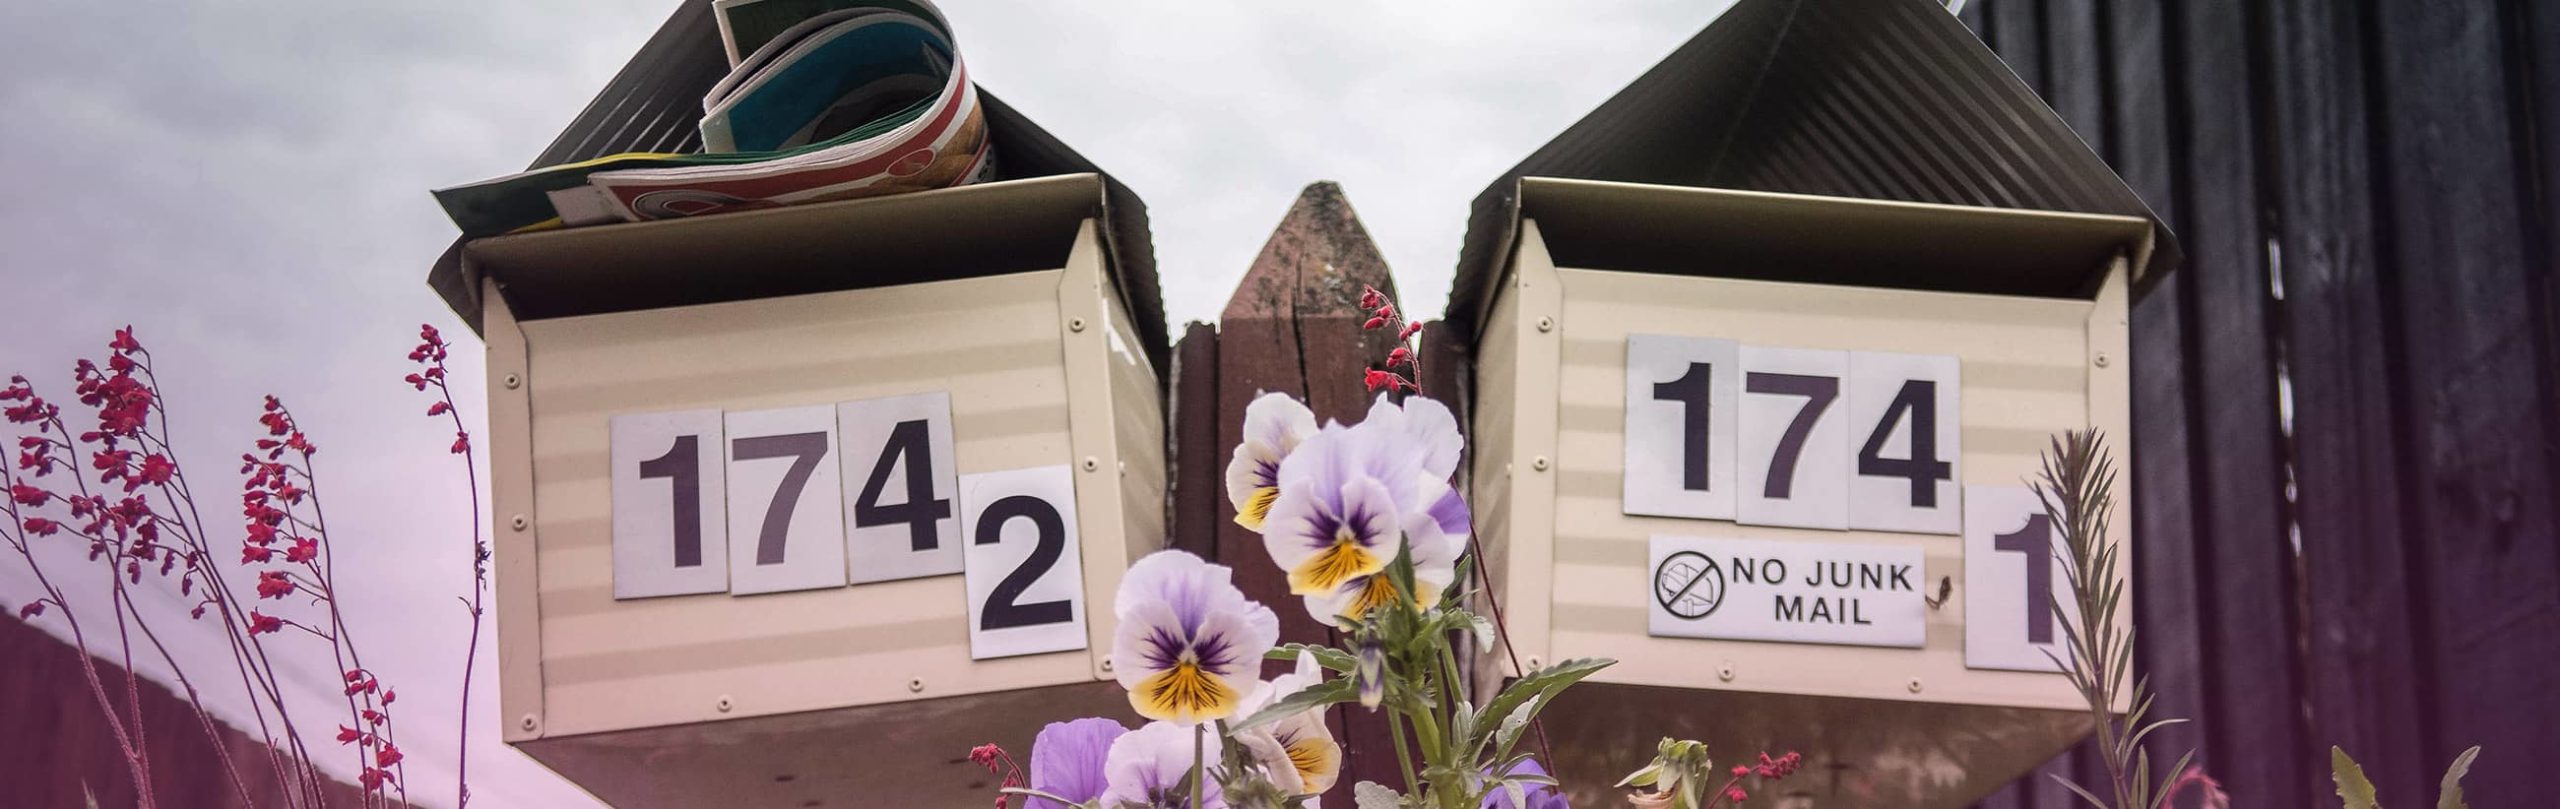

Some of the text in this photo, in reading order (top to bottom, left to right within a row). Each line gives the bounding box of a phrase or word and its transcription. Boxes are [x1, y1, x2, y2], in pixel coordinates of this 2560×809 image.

[639, 419, 951, 568] 174
[1653, 361, 1952, 508] 174
[974, 494, 1074, 631] 2
[1732, 557, 1914, 592] NO JUNK
[1774, 595, 1873, 626] MAIL
[1994, 513, 2054, 645] 1
